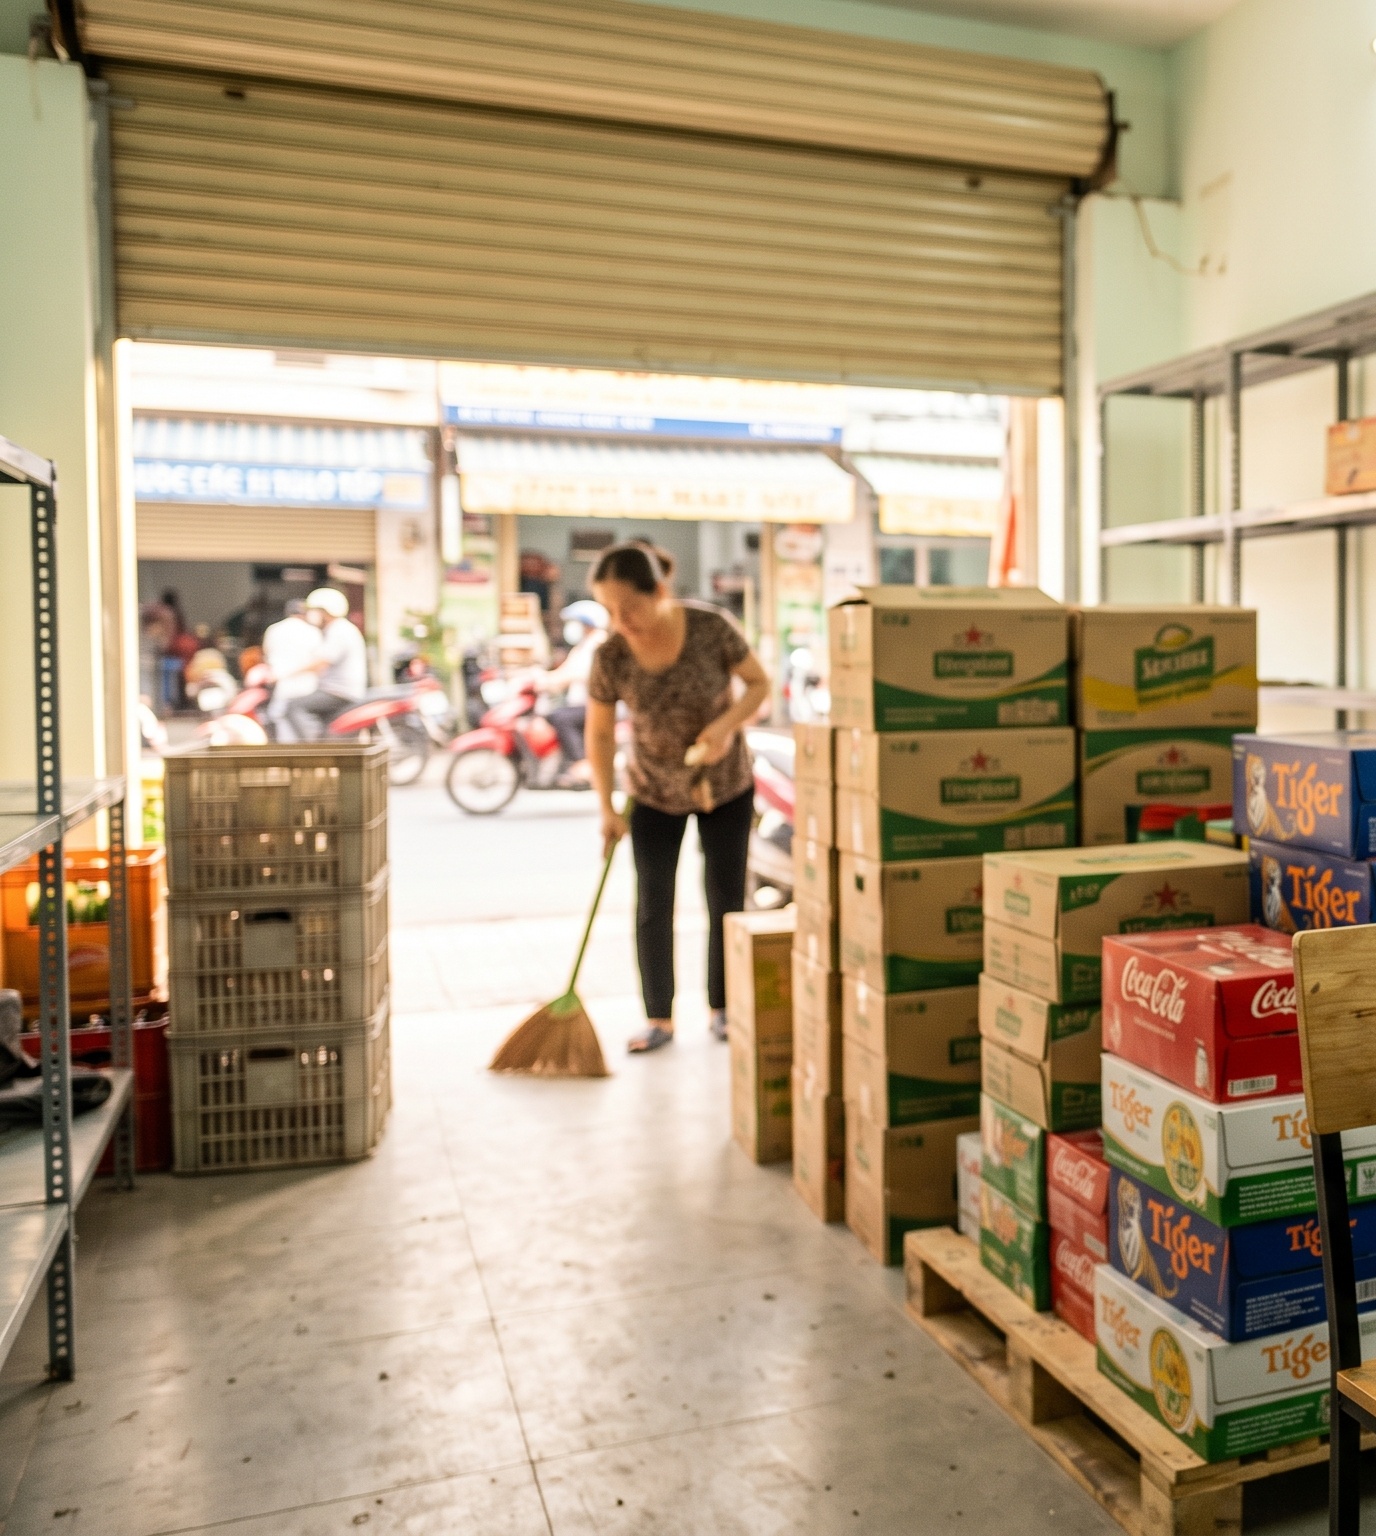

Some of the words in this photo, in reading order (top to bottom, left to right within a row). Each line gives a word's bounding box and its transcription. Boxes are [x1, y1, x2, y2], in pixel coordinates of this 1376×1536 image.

[1271, 760, 1344, 836] Tiger
[1286, 864, 1361, 928] Tiger
[1272, 1109, 1312, 1150] Tig
[1147, 1198, 1216, 1280] Tiger
[1261, 1332, 1329, 1380] Tige
